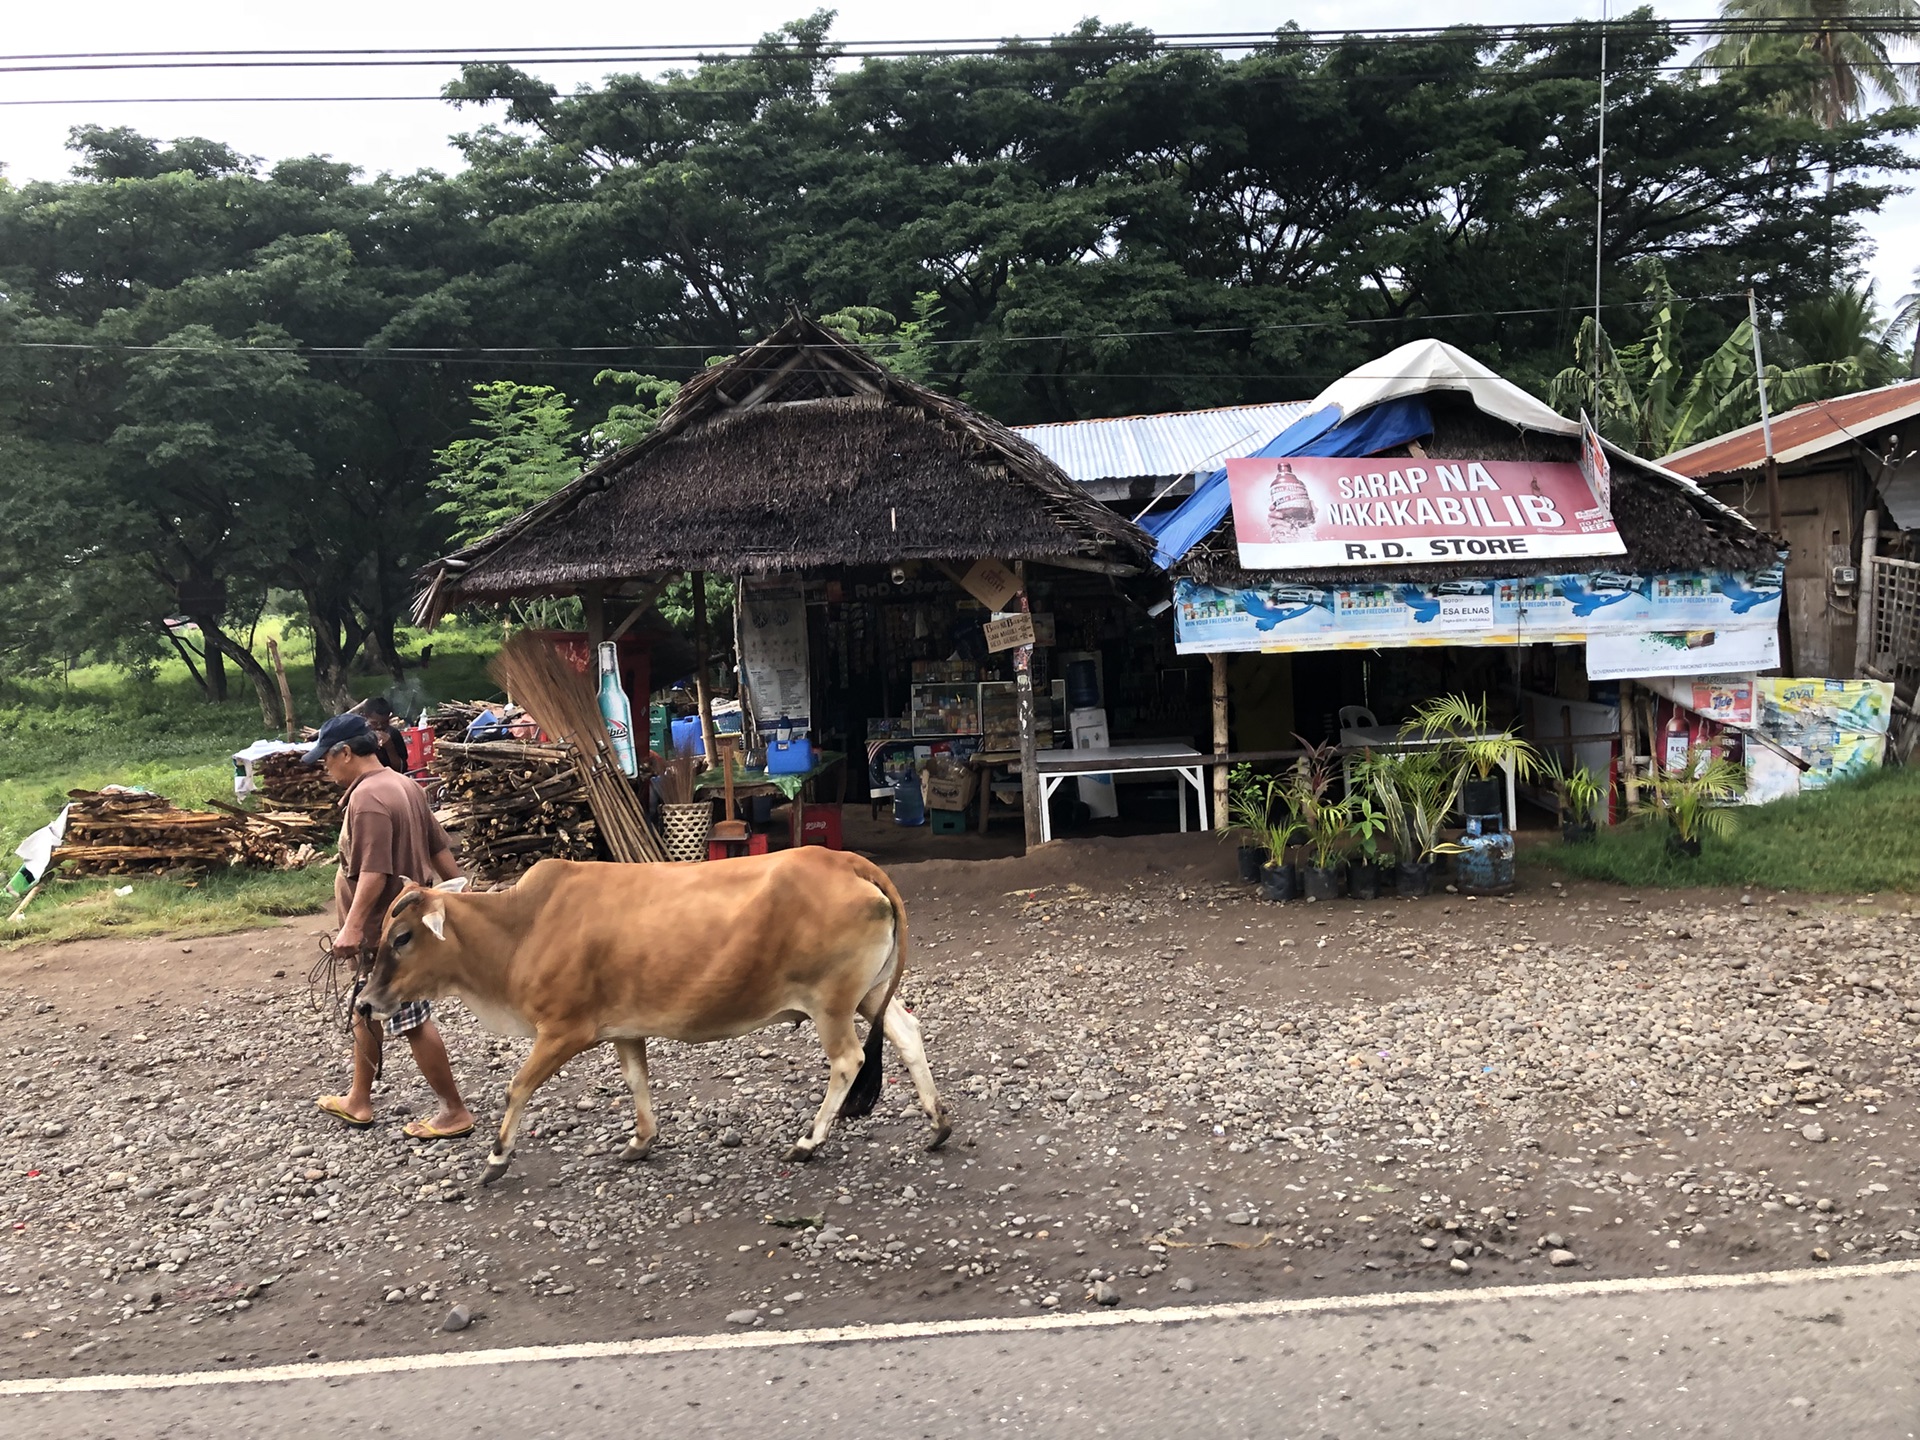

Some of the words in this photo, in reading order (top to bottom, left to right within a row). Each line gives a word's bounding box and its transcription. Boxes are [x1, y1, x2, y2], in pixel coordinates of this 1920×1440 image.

[1338, 466, 1429, 500] SARAP
[1435, 462, 1501, 493] NA
[1328, 494, 1566, 528] NAKAKABILIB
[1581, 522, 1612, 533] BEER
[1430, 538, 1529, 556] STORE
[1366, 607, 1390, 615] FREEDOM
[1443, 607, 1460, 616] ESA
[1462, 606, 1490, 615] ELNAS
[1592, 667, 1626, 675] GOVERNMENT
[1712, 695, 1734, 710] Tide
